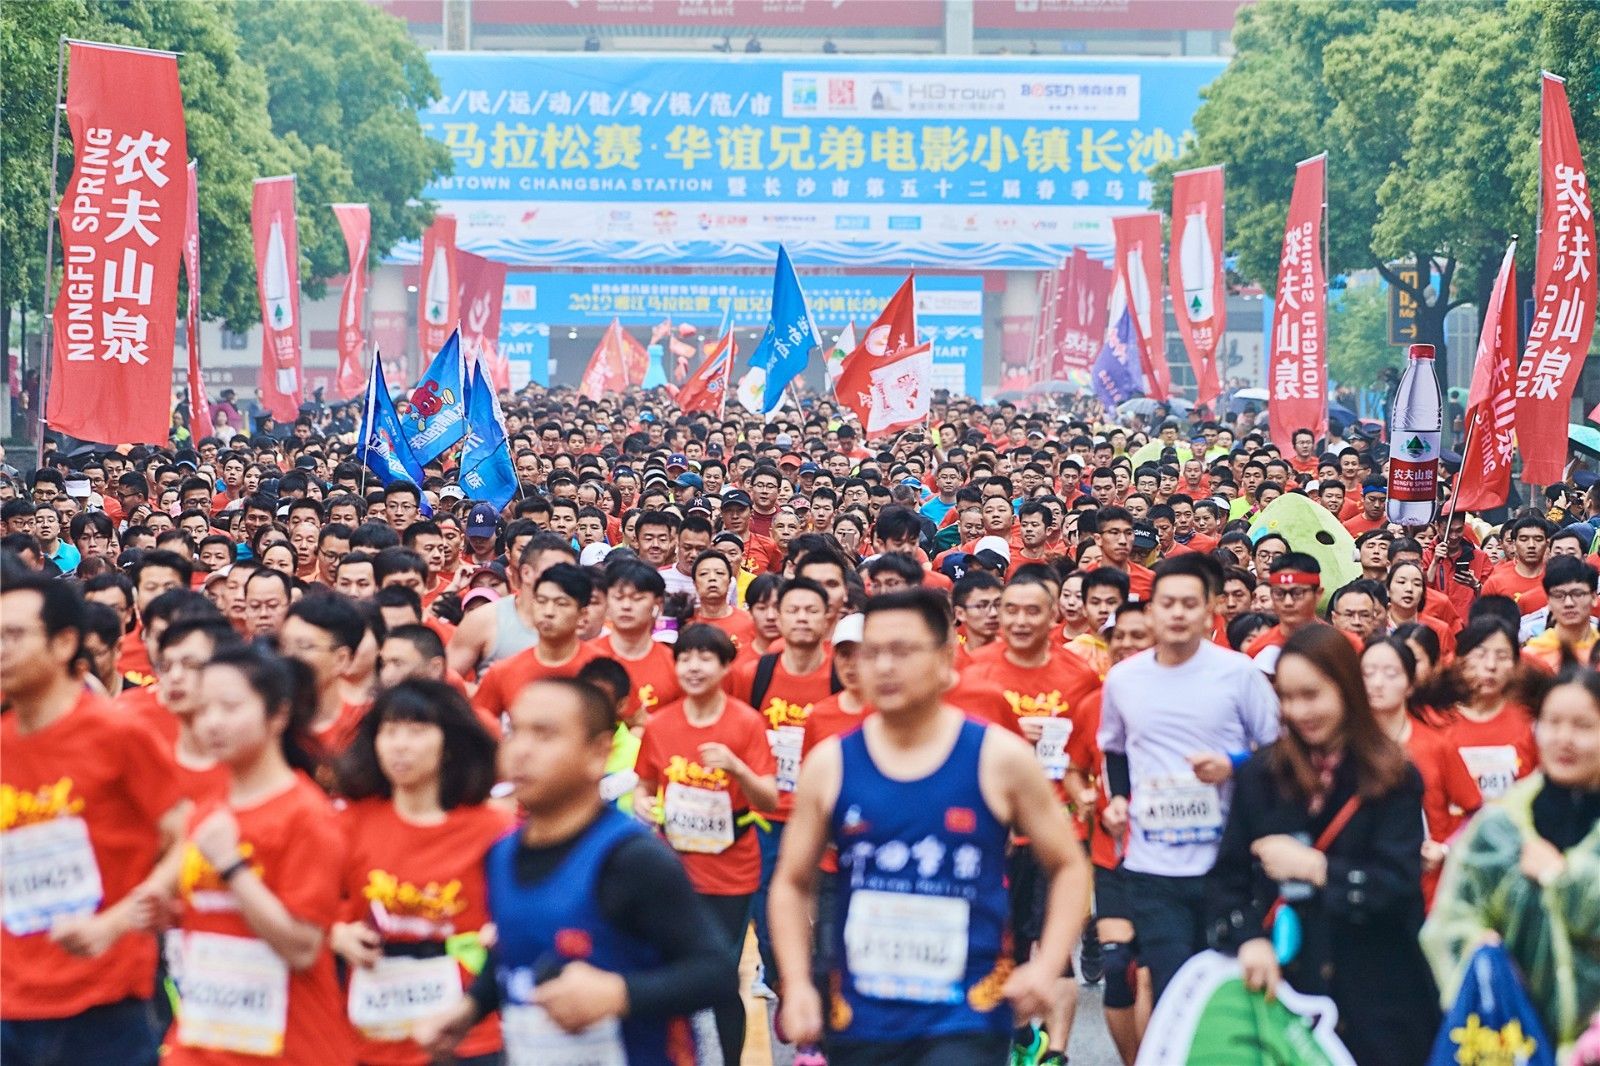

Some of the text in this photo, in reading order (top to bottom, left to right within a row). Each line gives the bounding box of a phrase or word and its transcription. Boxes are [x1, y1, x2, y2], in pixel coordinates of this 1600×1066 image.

[519, 176, 627, 191] CHANGSHA
[631, 177, 713, 192] STATION
[66, 126, 114, 362] NONGFU SPRING
[101, 129, 171, 366] 农夫山泉
[499, 342, 534, 355] TART
[934, 345, 968, 357] TART
[1475, 408, 1498, 476] SPRING
[1393, 468, 1433, 480] 农夫山泉
